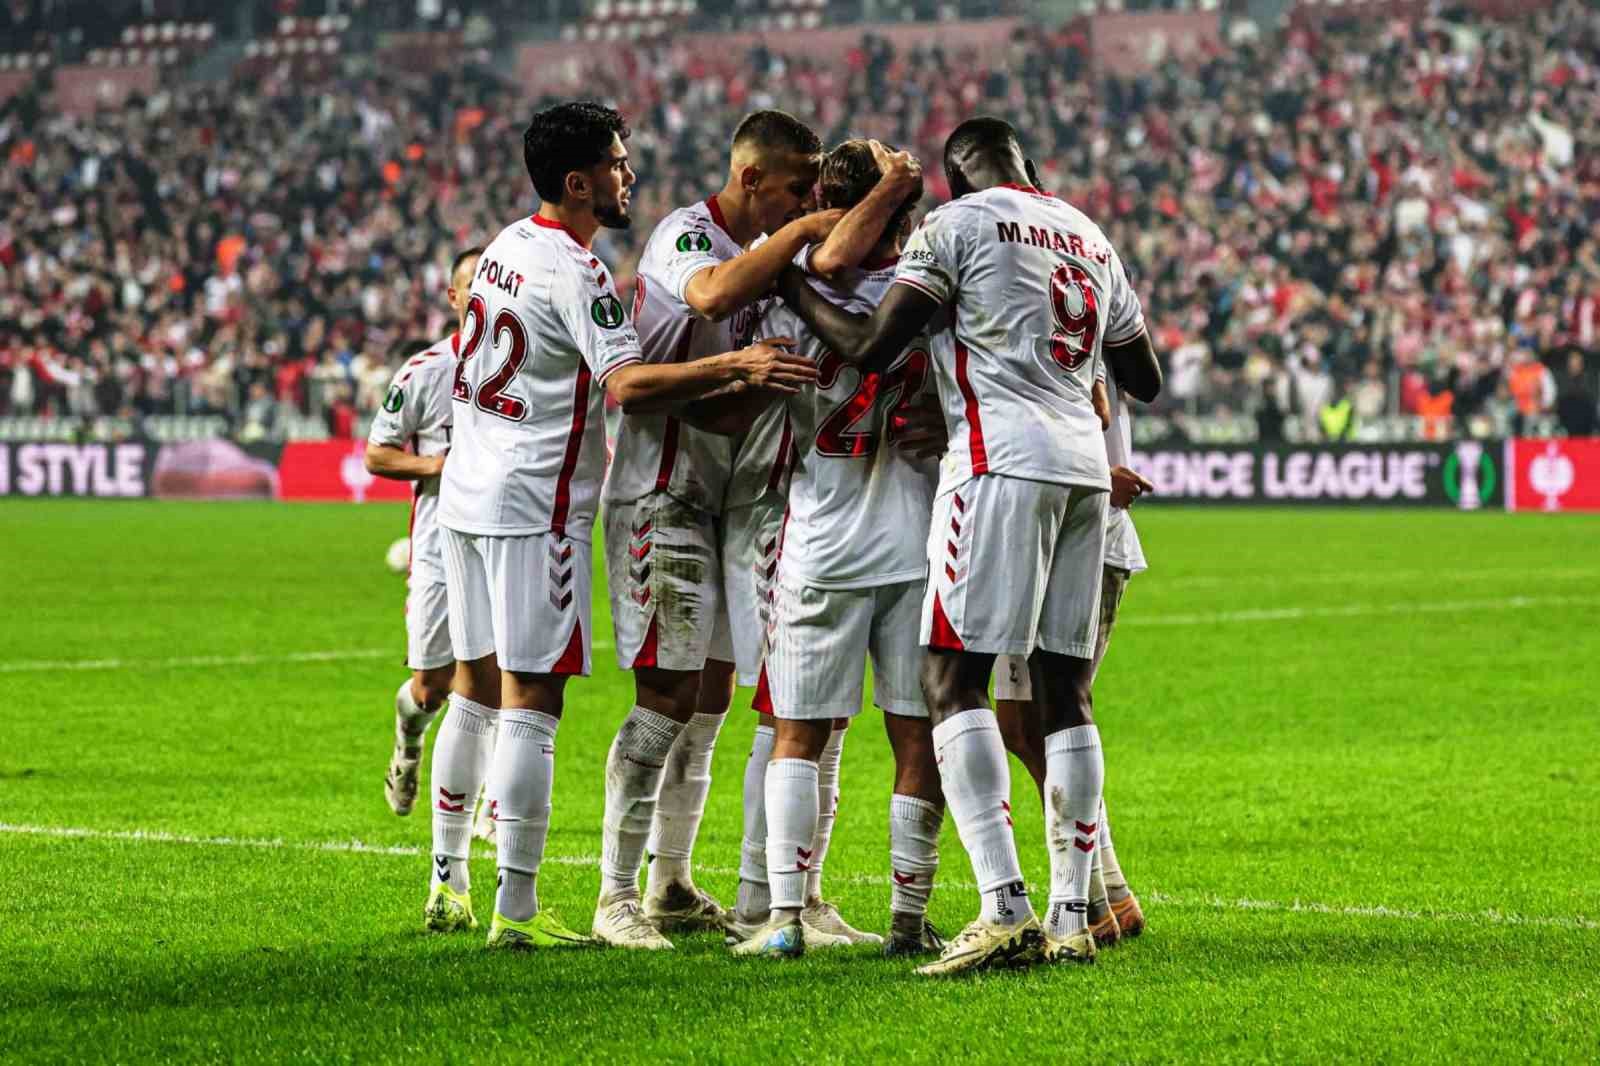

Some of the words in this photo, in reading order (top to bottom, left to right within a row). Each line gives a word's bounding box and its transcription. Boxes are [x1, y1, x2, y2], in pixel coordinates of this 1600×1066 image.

[477, 257, 525, 299] POLAT
[1049, 262, 1099, 373] 9
[451, 292, 530, 423] 22
[17, 442, 145, 497] STYLE
[1262, 451, 1427, 498] LEAGUE
